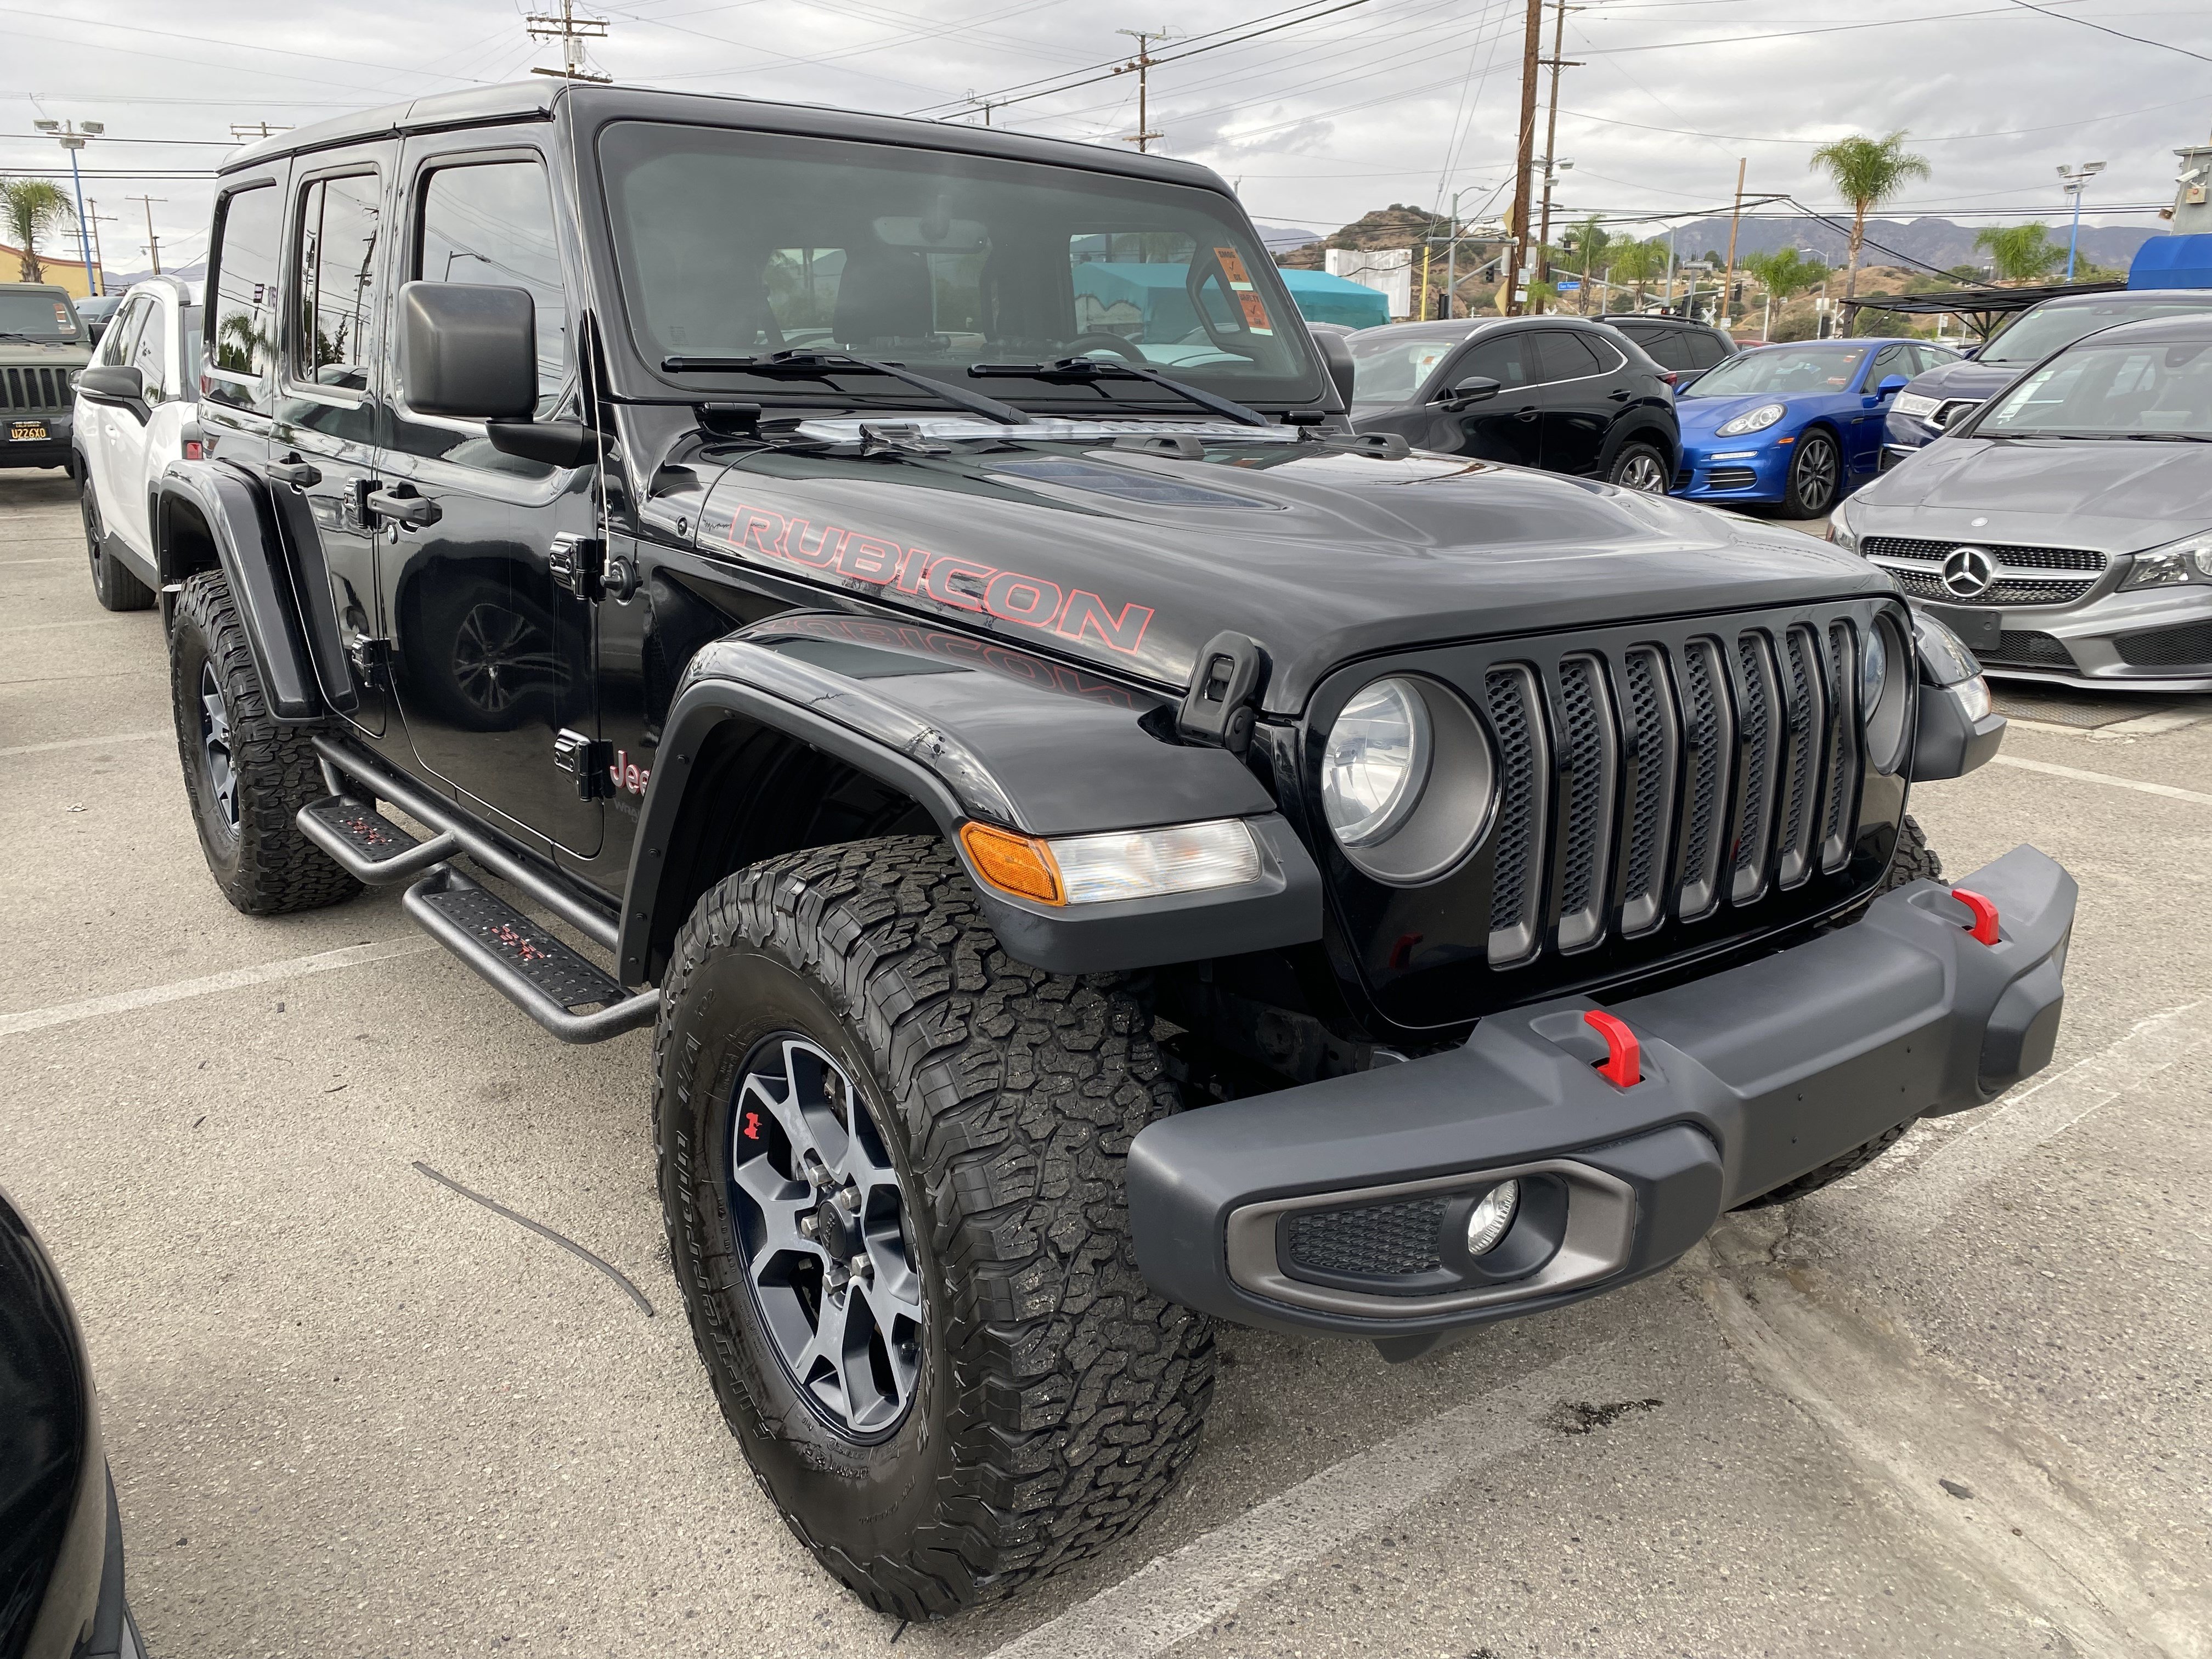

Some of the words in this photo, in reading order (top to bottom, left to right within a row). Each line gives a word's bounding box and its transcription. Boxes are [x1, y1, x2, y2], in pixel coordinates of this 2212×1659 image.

[1239, 294, 1259, 302] SAFETY
[727, 504, 1155, 656] RUBICON
[610, 750, 650, 797] Jee
